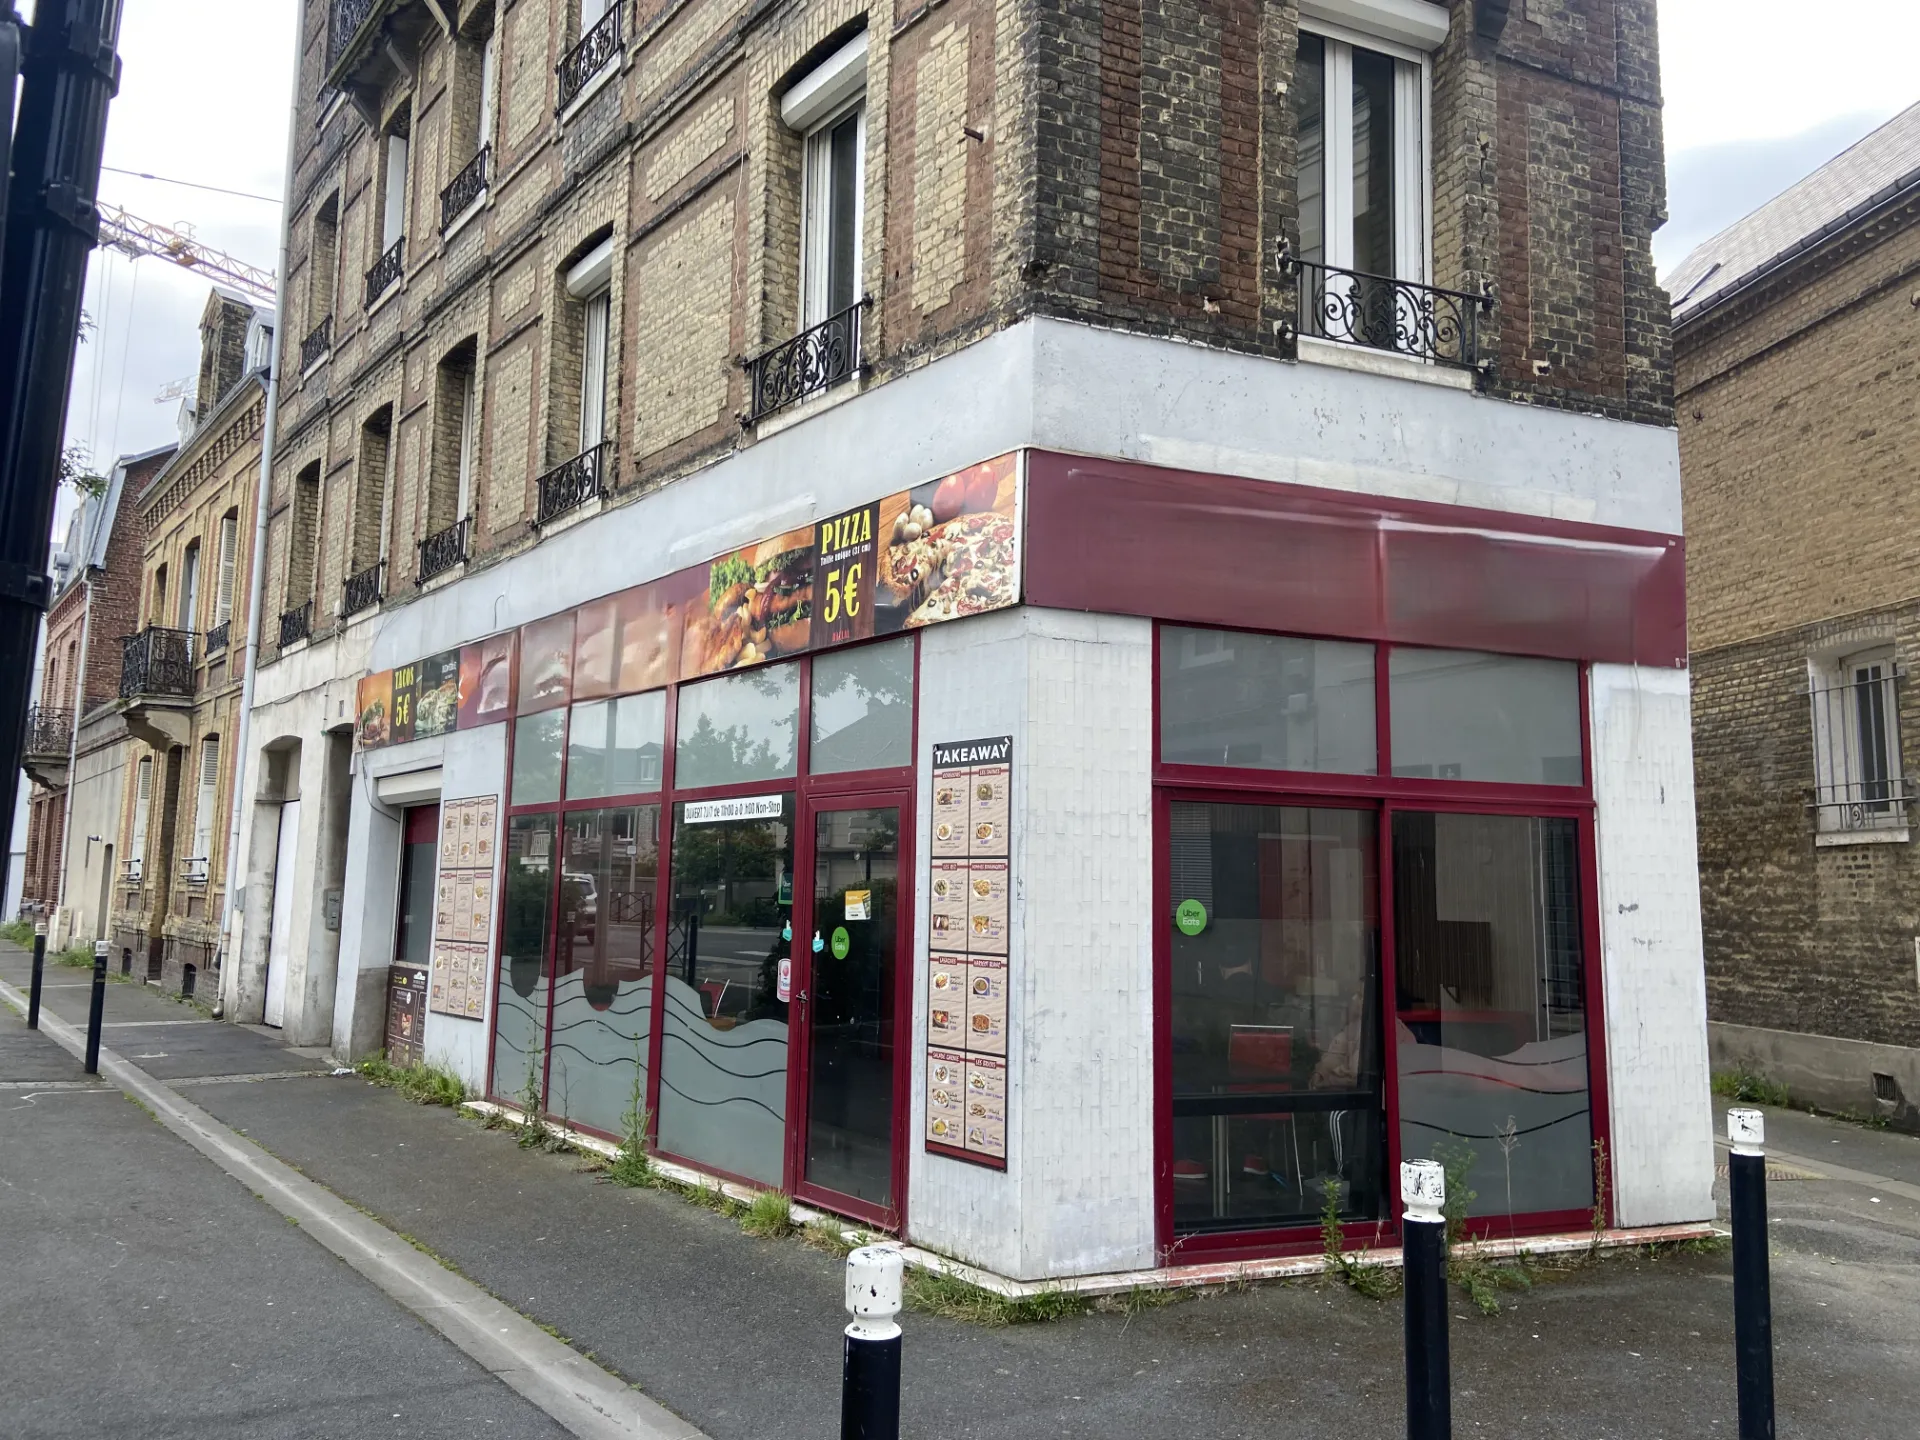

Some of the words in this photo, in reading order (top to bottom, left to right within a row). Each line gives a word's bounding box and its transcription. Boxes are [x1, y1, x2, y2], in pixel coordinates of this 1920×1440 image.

[821, 509, 871, 554] PIZZA
[824, 562, 862, 623] 5€
[395, 666, 414, 690] TACOS
[395, 693, 411, 727] 5€
[935, 743, 1009, 764] TAKEAWAY
[686, 807, 703, 819] OUVERT
[713, 805, 720, 817] de
[734, 804, 739, 816] à
[755, 800, 781, 815] Non-Stop
[1182, 909, 1200, 917] Uber
[1182, 917, 1200, 926] Eats
[835, 935, 846, 943] Uber
